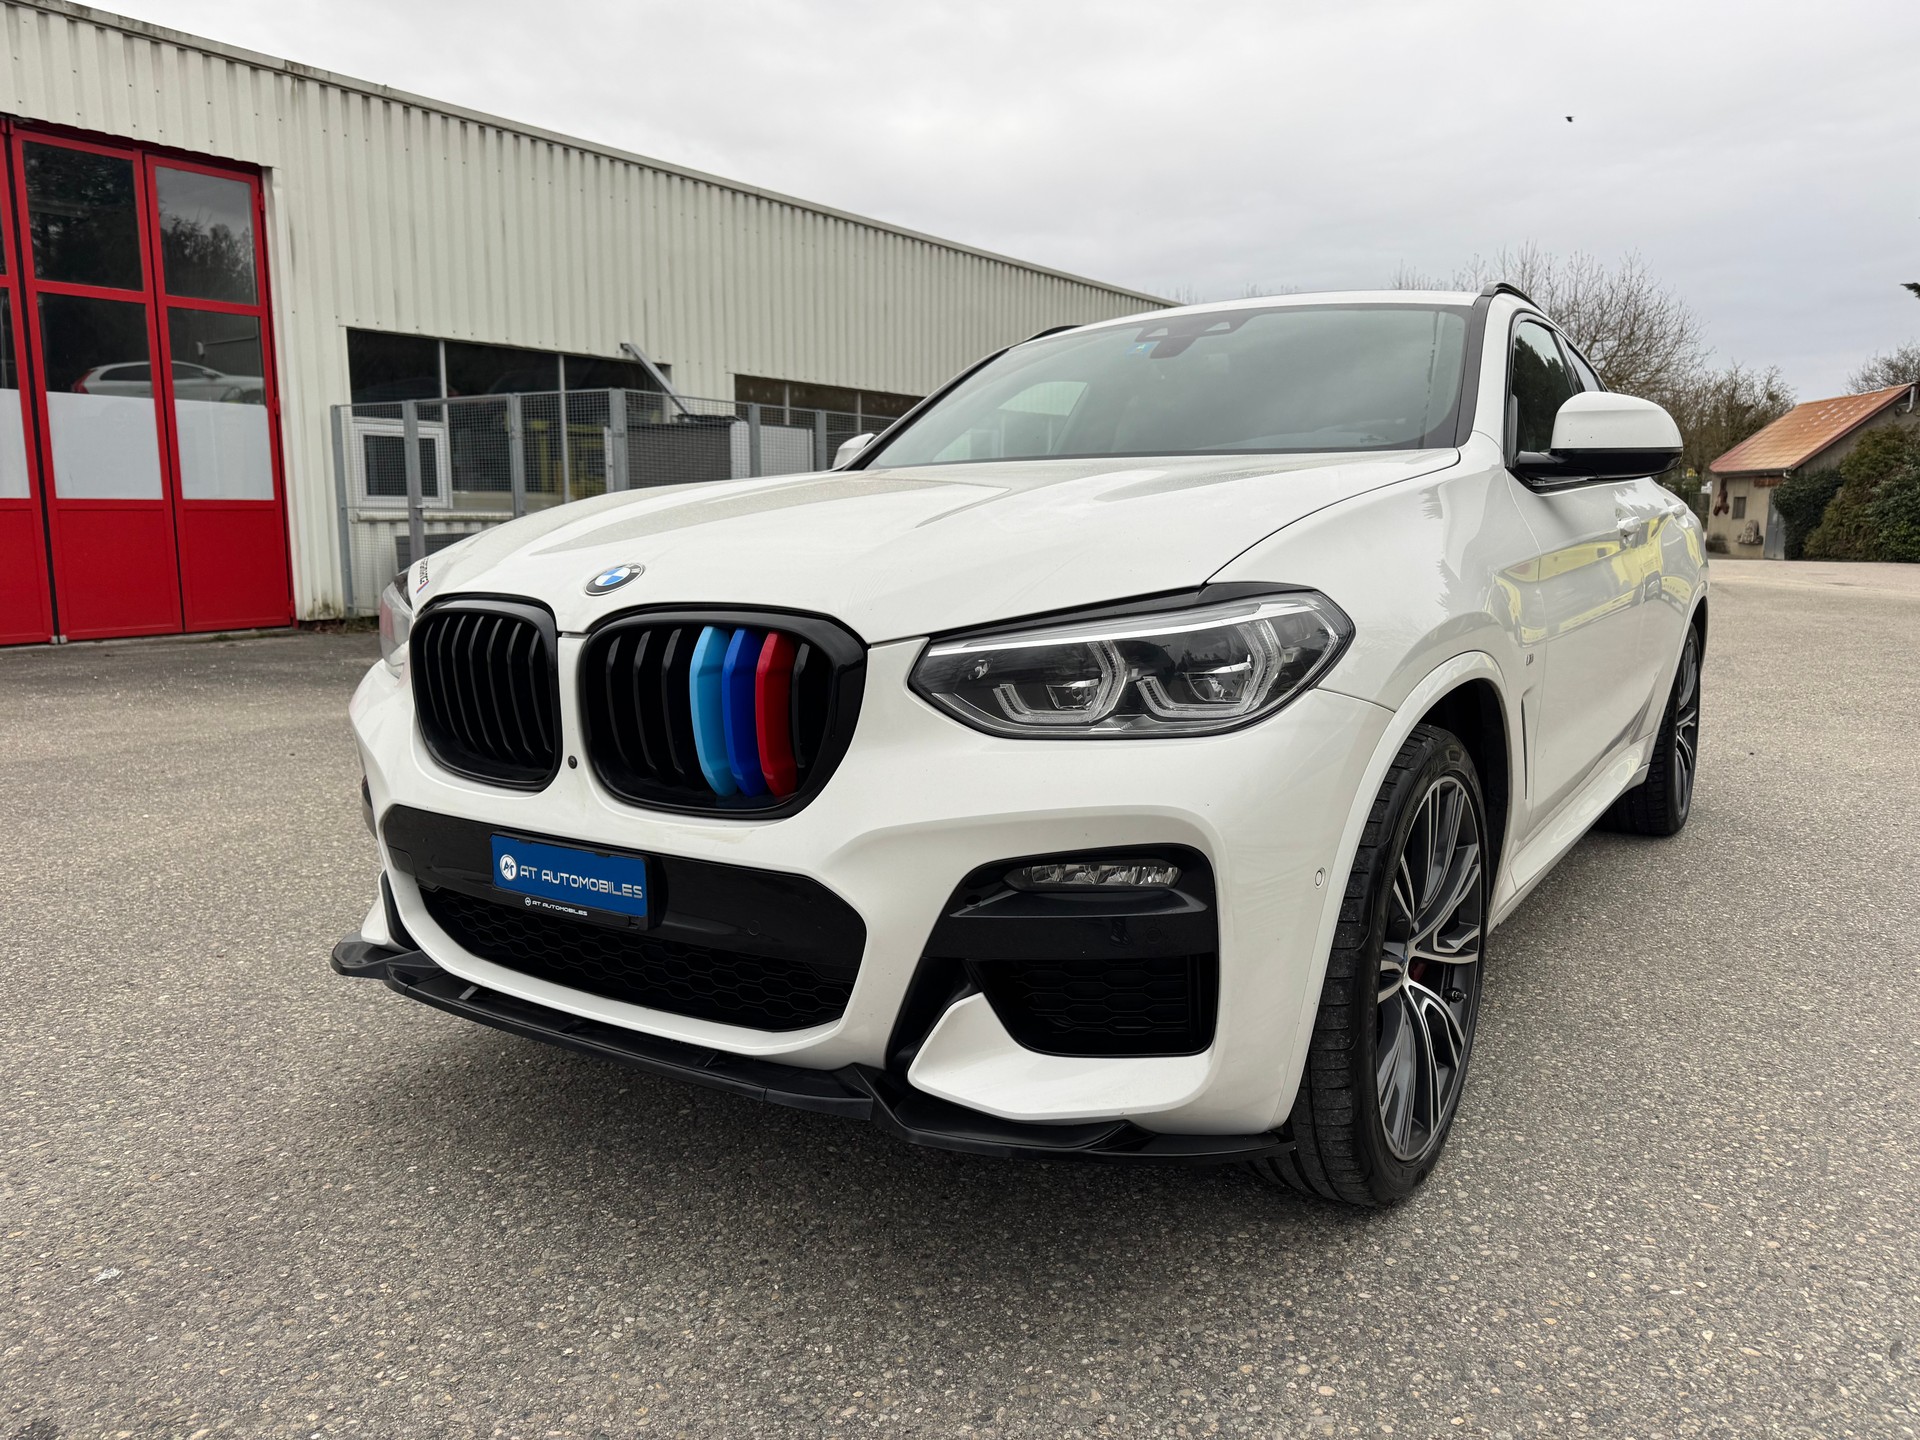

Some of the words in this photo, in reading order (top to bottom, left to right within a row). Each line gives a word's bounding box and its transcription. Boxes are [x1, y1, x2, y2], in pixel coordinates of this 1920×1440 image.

[520, 865, 538, 880] AT
[541, 869, 643, 899] AUTOMOBILES
[542, 902, 588, 916] AUTOMOBILES
